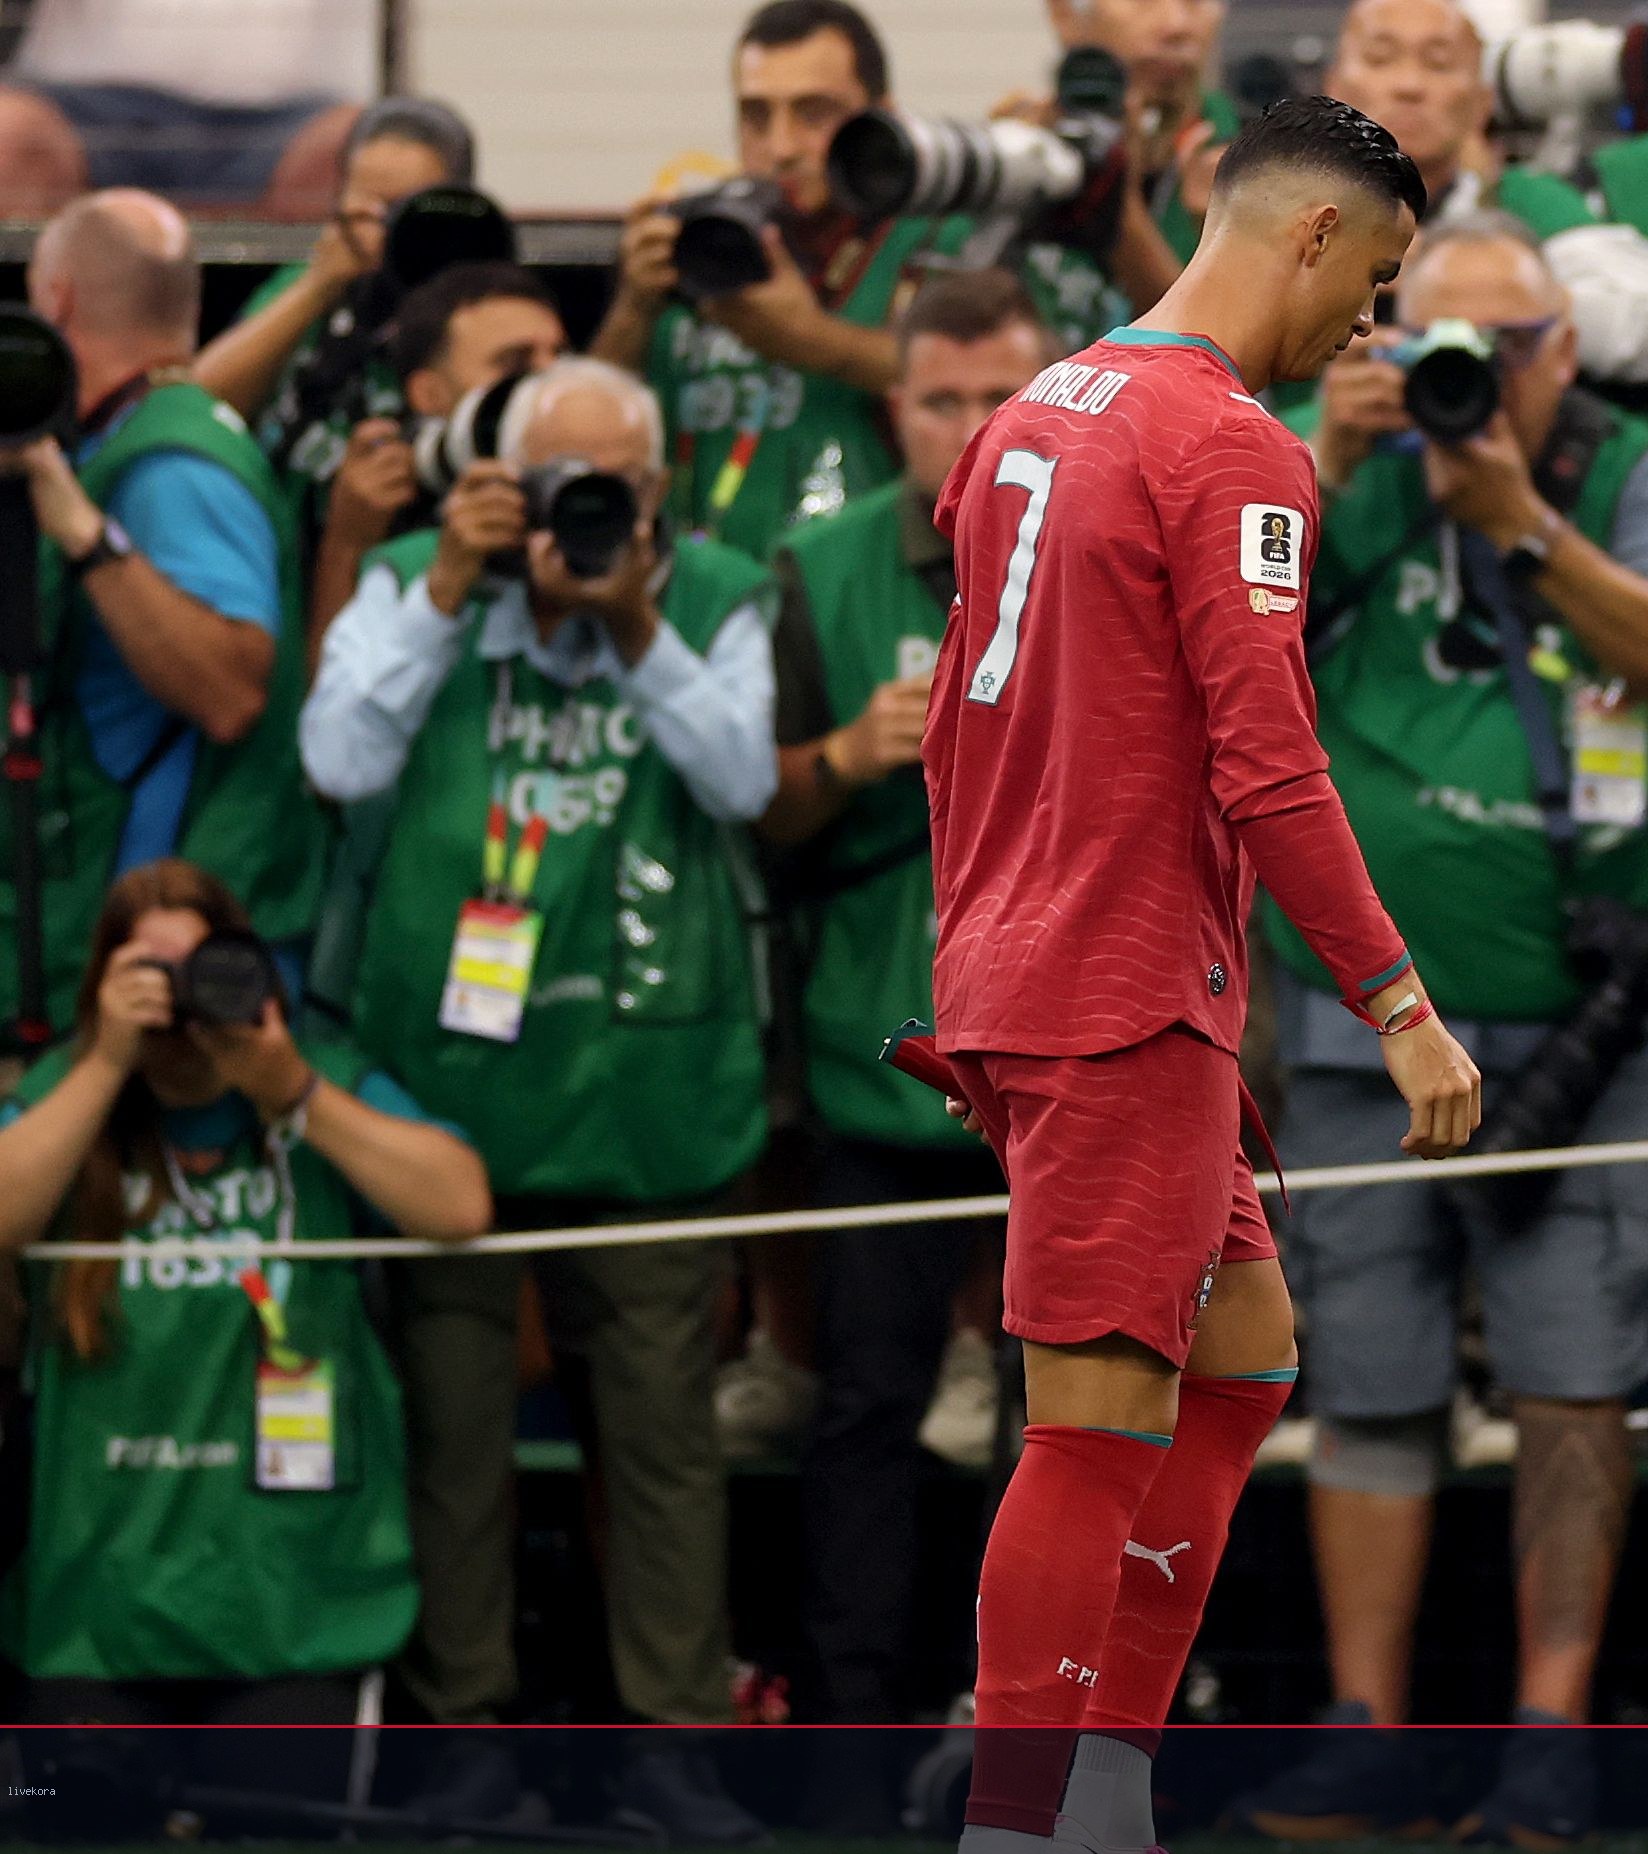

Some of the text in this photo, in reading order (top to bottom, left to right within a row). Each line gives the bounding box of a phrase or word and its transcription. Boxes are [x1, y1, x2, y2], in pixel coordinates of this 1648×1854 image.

[1269, 551, 1285, 560] FIFA
[965, 448, 1061, 706] 7
[1260, 569, 1292, 581] 2026
[487, 704, 646, 765] PHTO
